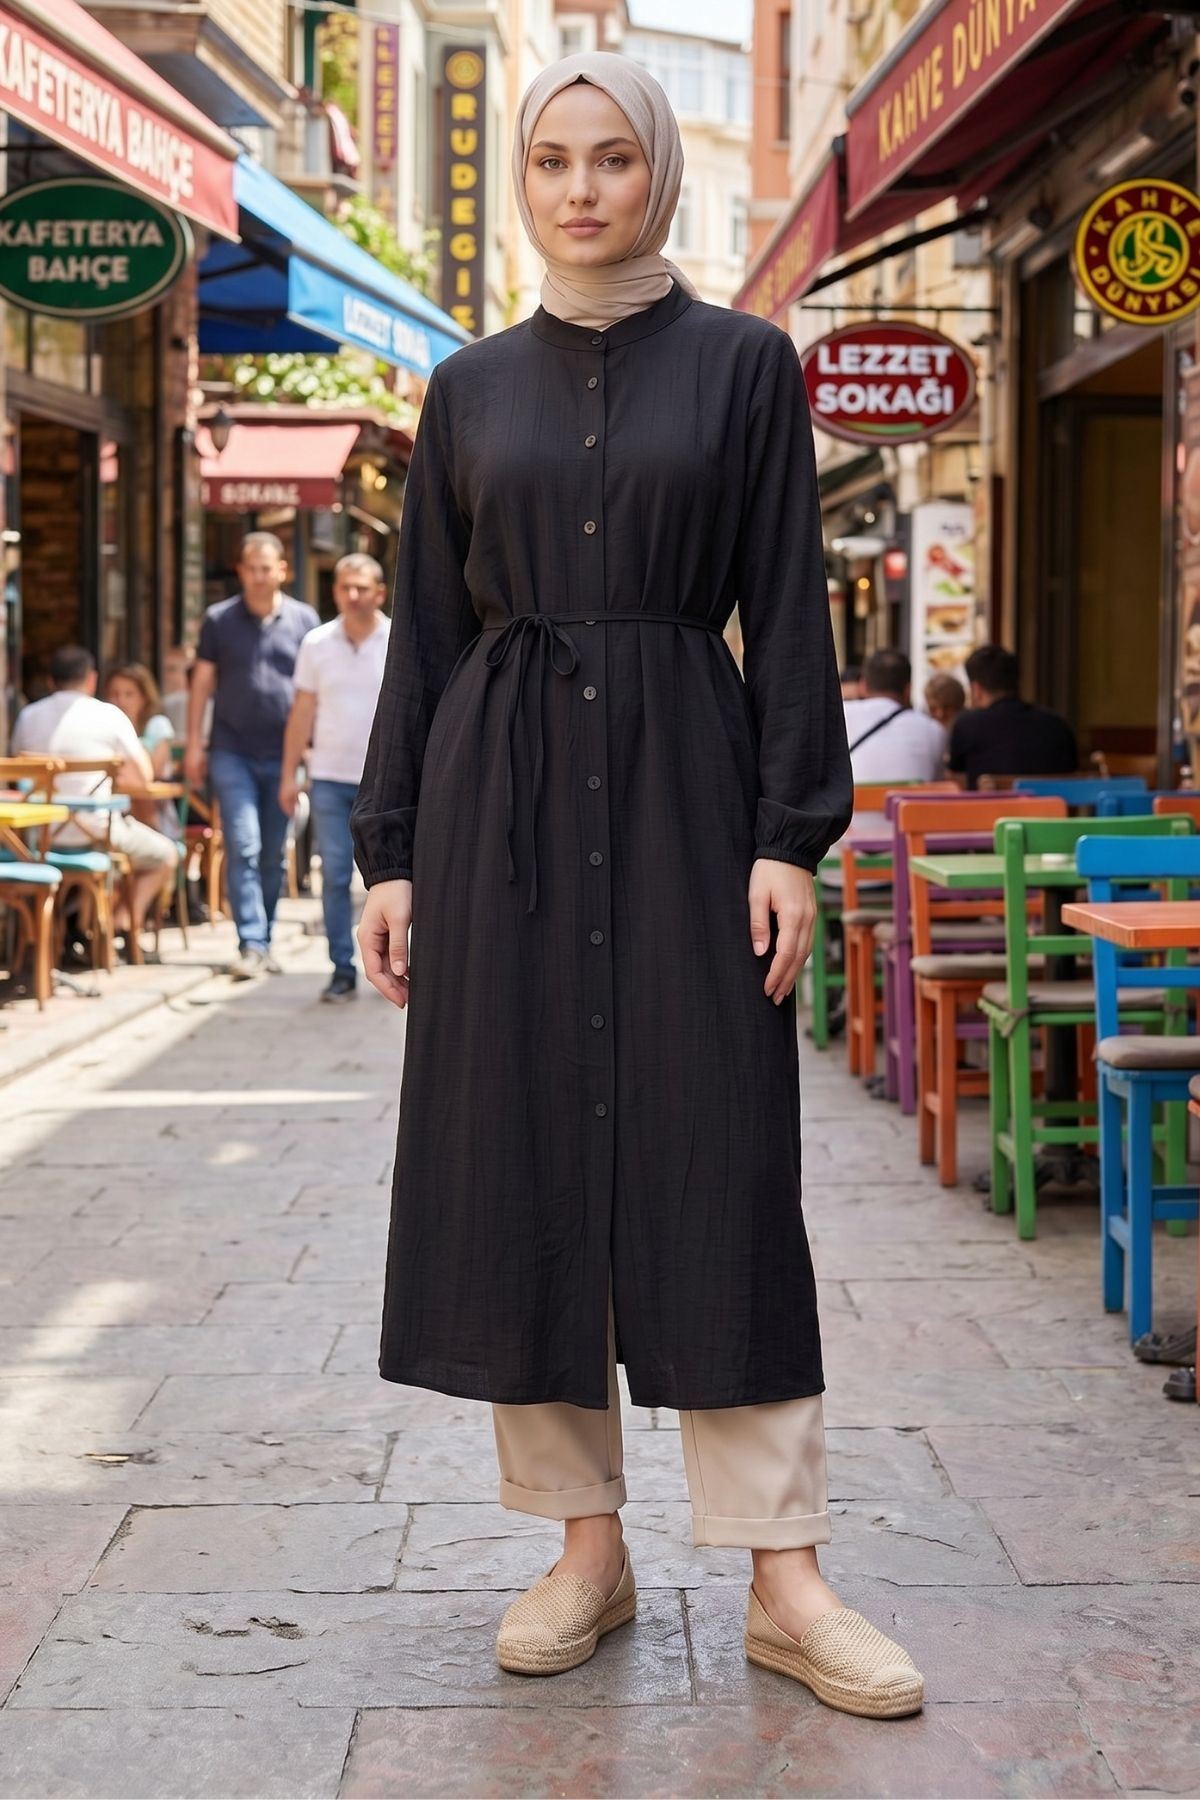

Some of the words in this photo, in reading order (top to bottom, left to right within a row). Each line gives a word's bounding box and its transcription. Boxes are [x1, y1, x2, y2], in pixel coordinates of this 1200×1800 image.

[0, 23, 124, 158] KAFETERYA
[127, 107, 194, 203] BAHÇE
[878, 44, 945, 164] KAHVE
[0, 220, 165, 248] KAFETERYA
[27, 255, 130, 290] BAHÇE
[817, 344, 954, 376] LEZZET
[814, 377, 955, 415] SOKAĞI
